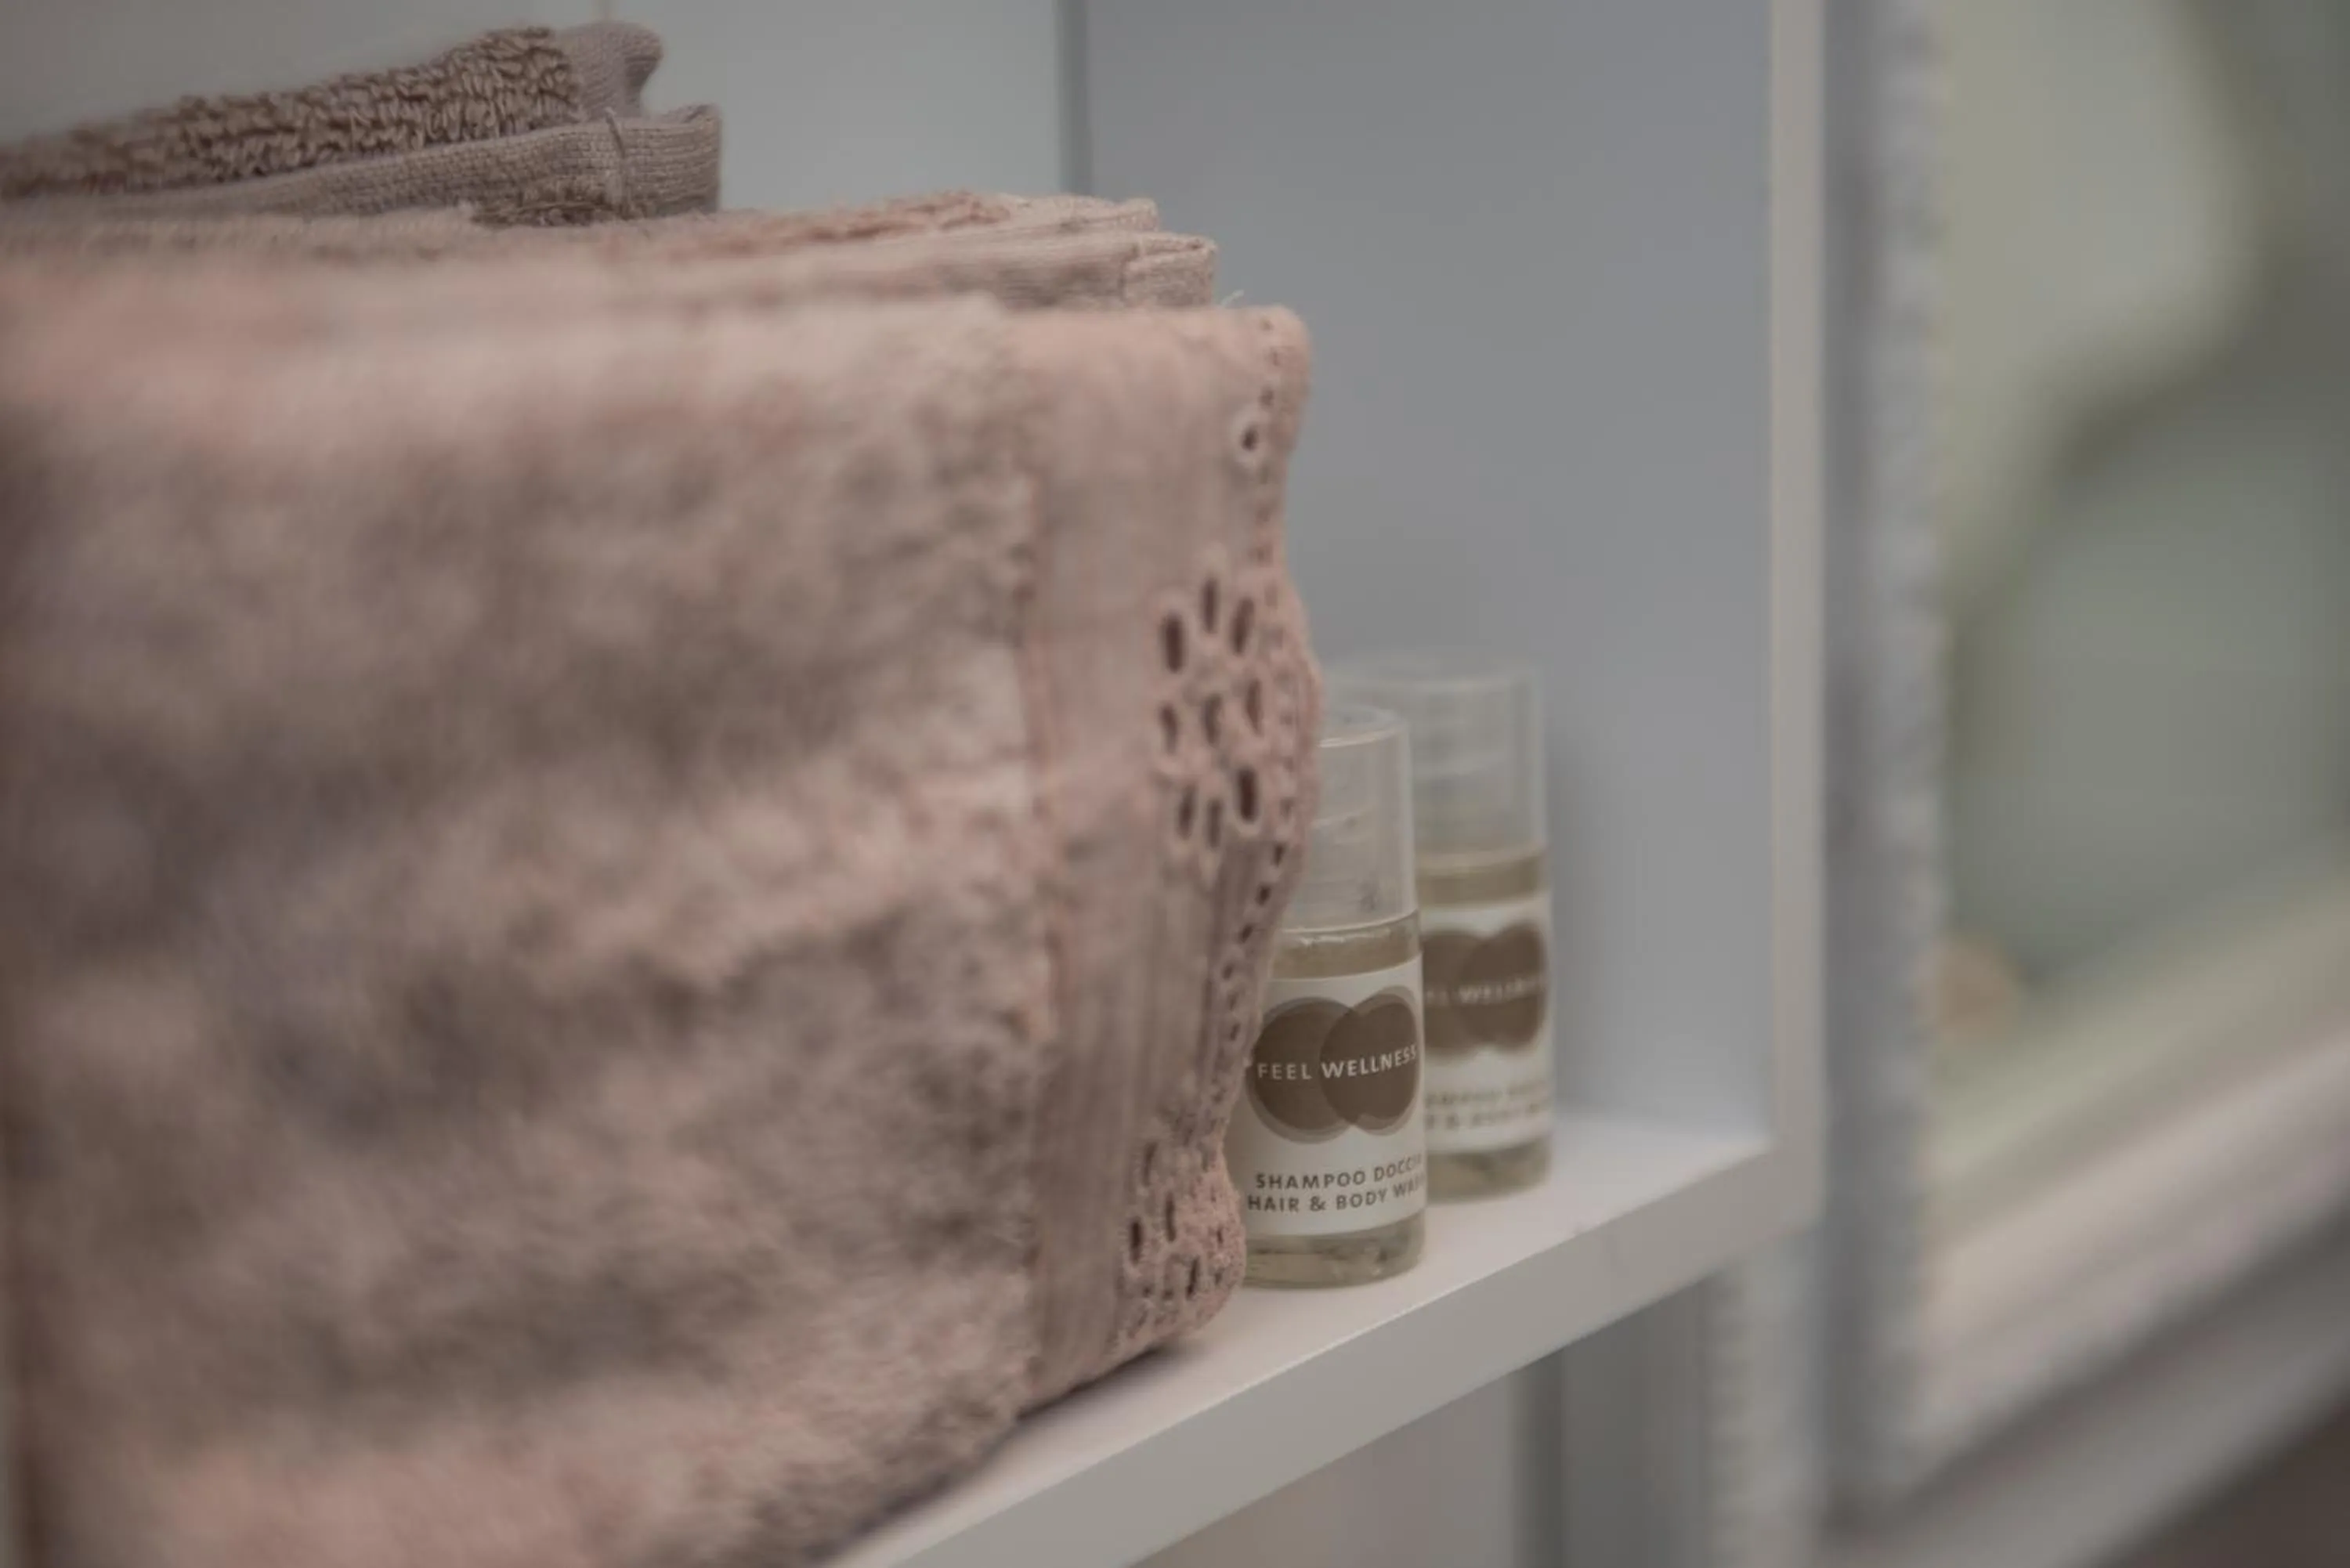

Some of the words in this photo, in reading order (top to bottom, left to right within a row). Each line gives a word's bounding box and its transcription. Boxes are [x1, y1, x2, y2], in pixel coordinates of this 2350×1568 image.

[1257, 1062, 1313, 1080] FEEL
[1321, 1044, 1417, 1079] WELLNESS
[1256, 1170, 1365, 1190] SHAMPOO
[1248, 1194, 1300, 1213] HAIR
[1310, 1195, 1326, 1212] &
[1336, 1188, 1387, 1211] BODY
